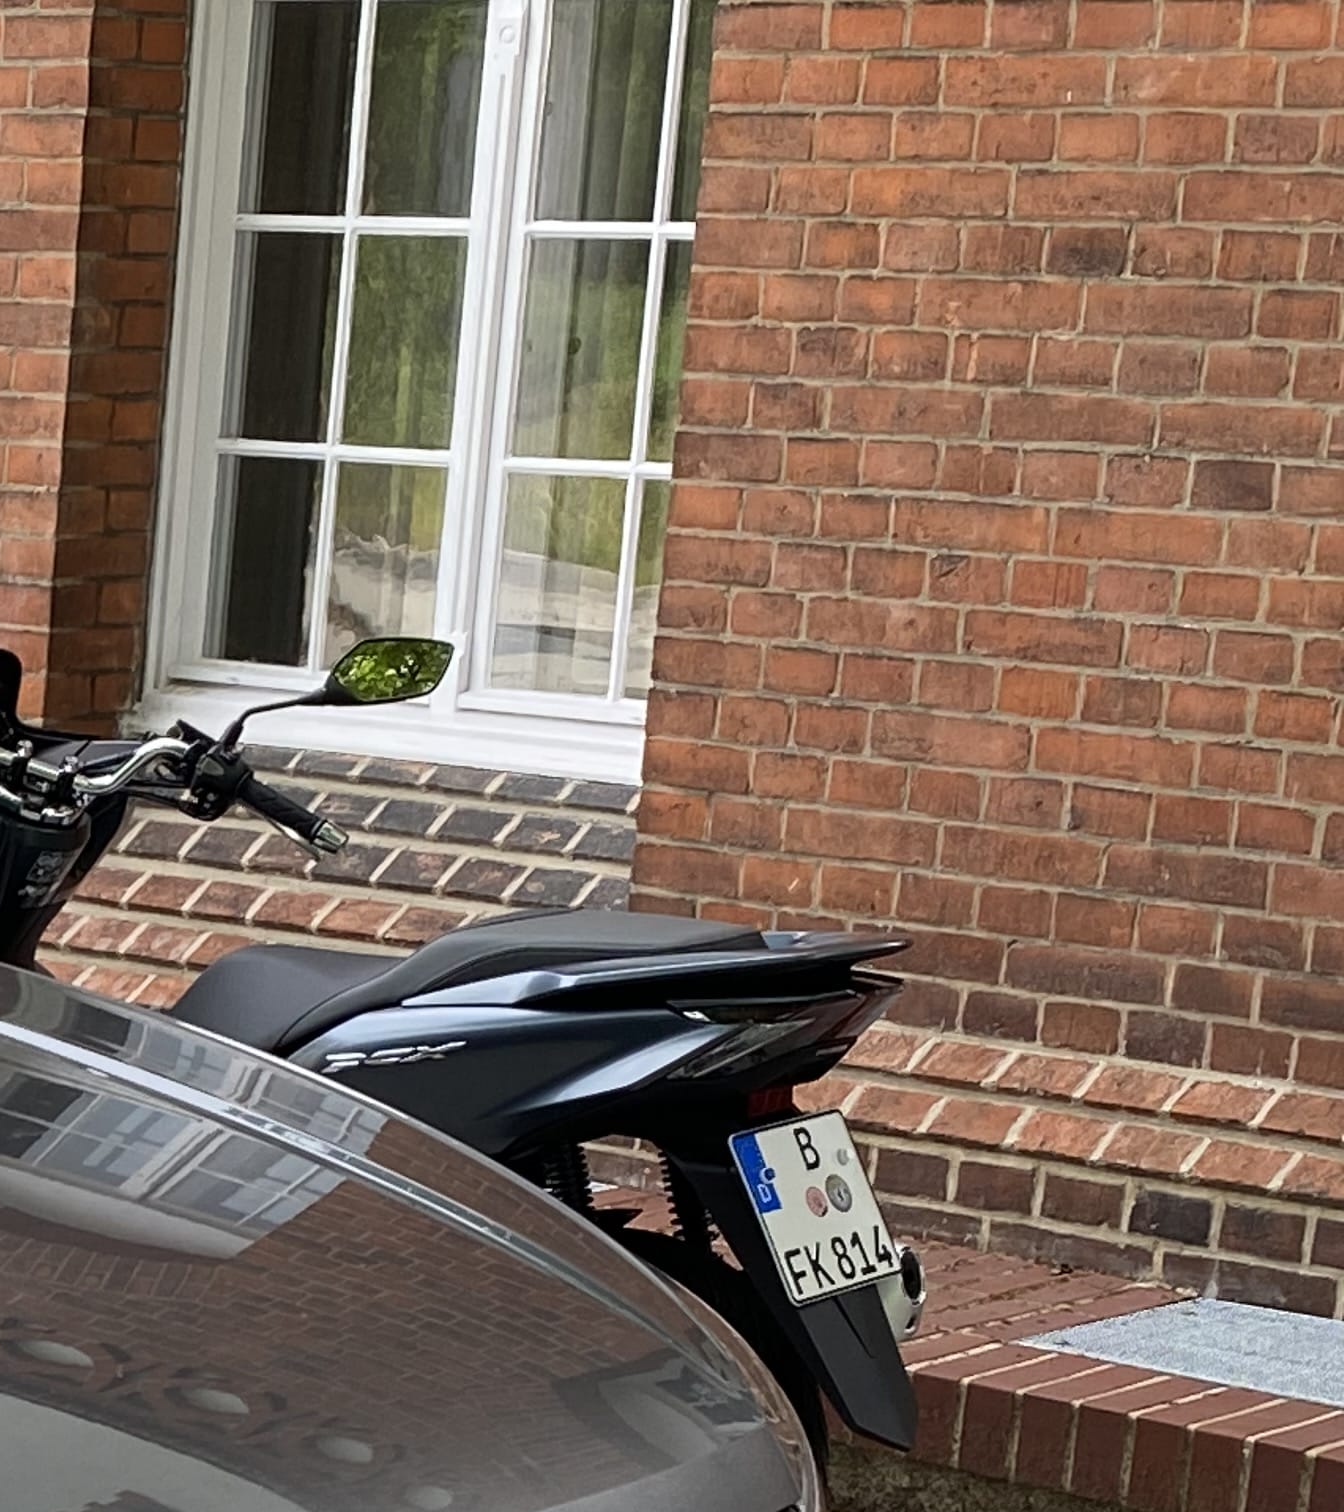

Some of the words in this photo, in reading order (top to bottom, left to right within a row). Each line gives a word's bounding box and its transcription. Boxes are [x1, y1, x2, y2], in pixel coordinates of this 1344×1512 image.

[321, 1041, 467, 1074] PCX
[793, 1127, 821, 1171] B
[784, 1242, 836, 1295] FK
[831, 1225, 894, 1279] 814
